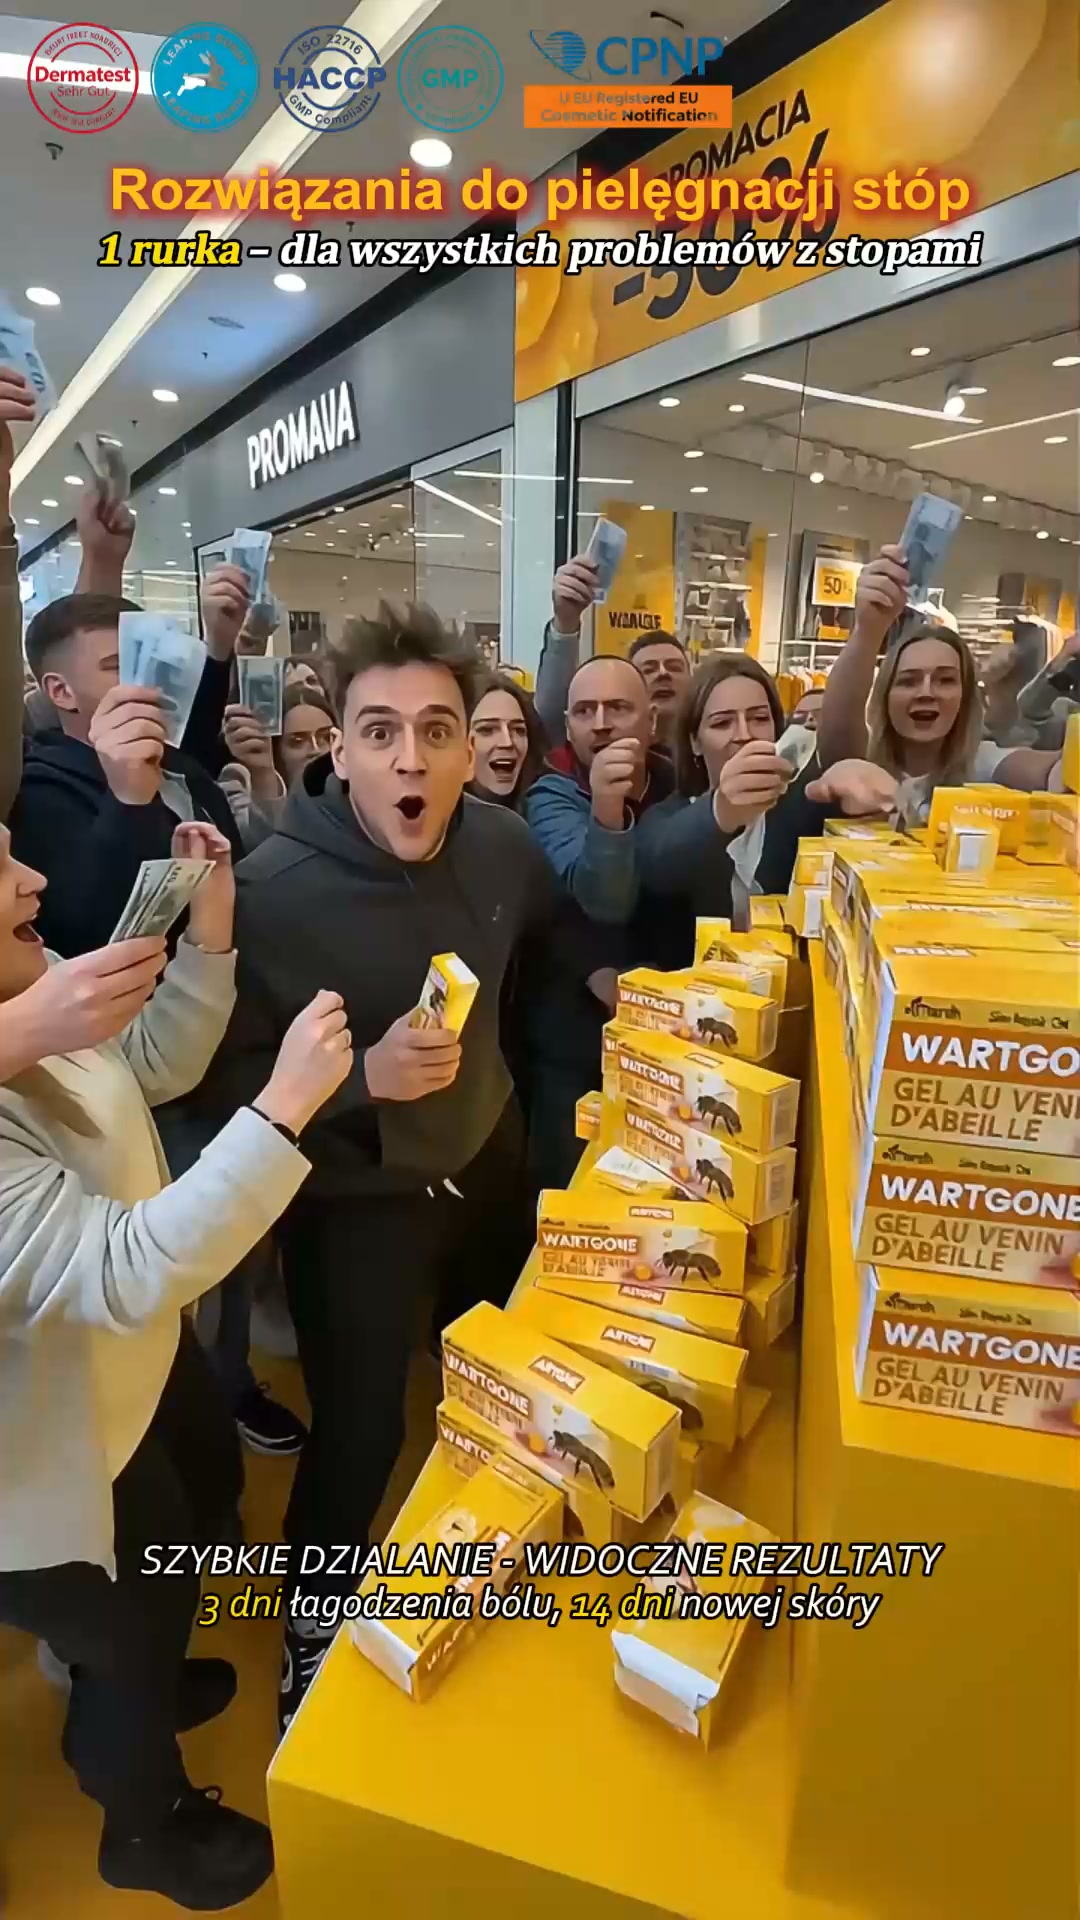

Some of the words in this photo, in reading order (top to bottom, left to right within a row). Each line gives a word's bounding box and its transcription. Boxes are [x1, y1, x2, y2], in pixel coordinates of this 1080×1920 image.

[247, 380, 360, 490] PROMAVA
[902, 1032, 1080, 1077] WARTGO
[894, 1077, 949, 1106] GEL
[955, 1083, 1001, 1109] AU
[891, 1103, 1042, 1142] D'ABEILLE
[881, 1174, 1080, 1222] WARTGONE
[872, 1236, 1006, 1273] D'ABEILLE
[875, 1212, 924, 1238] GEL
[931, 1218, 970, 1243] AU
[980, 1225, 1064, 1256] VENIN
[883, 1320, 1080, 1371] WARTGONE
[874, 1379, 1006, 1417] D'ABEILLE
[876, 1356, 924, 1382] GEL
[931, 1362, 970, 1388] AU
[980, 1370, 1064, 1403] VENIN
